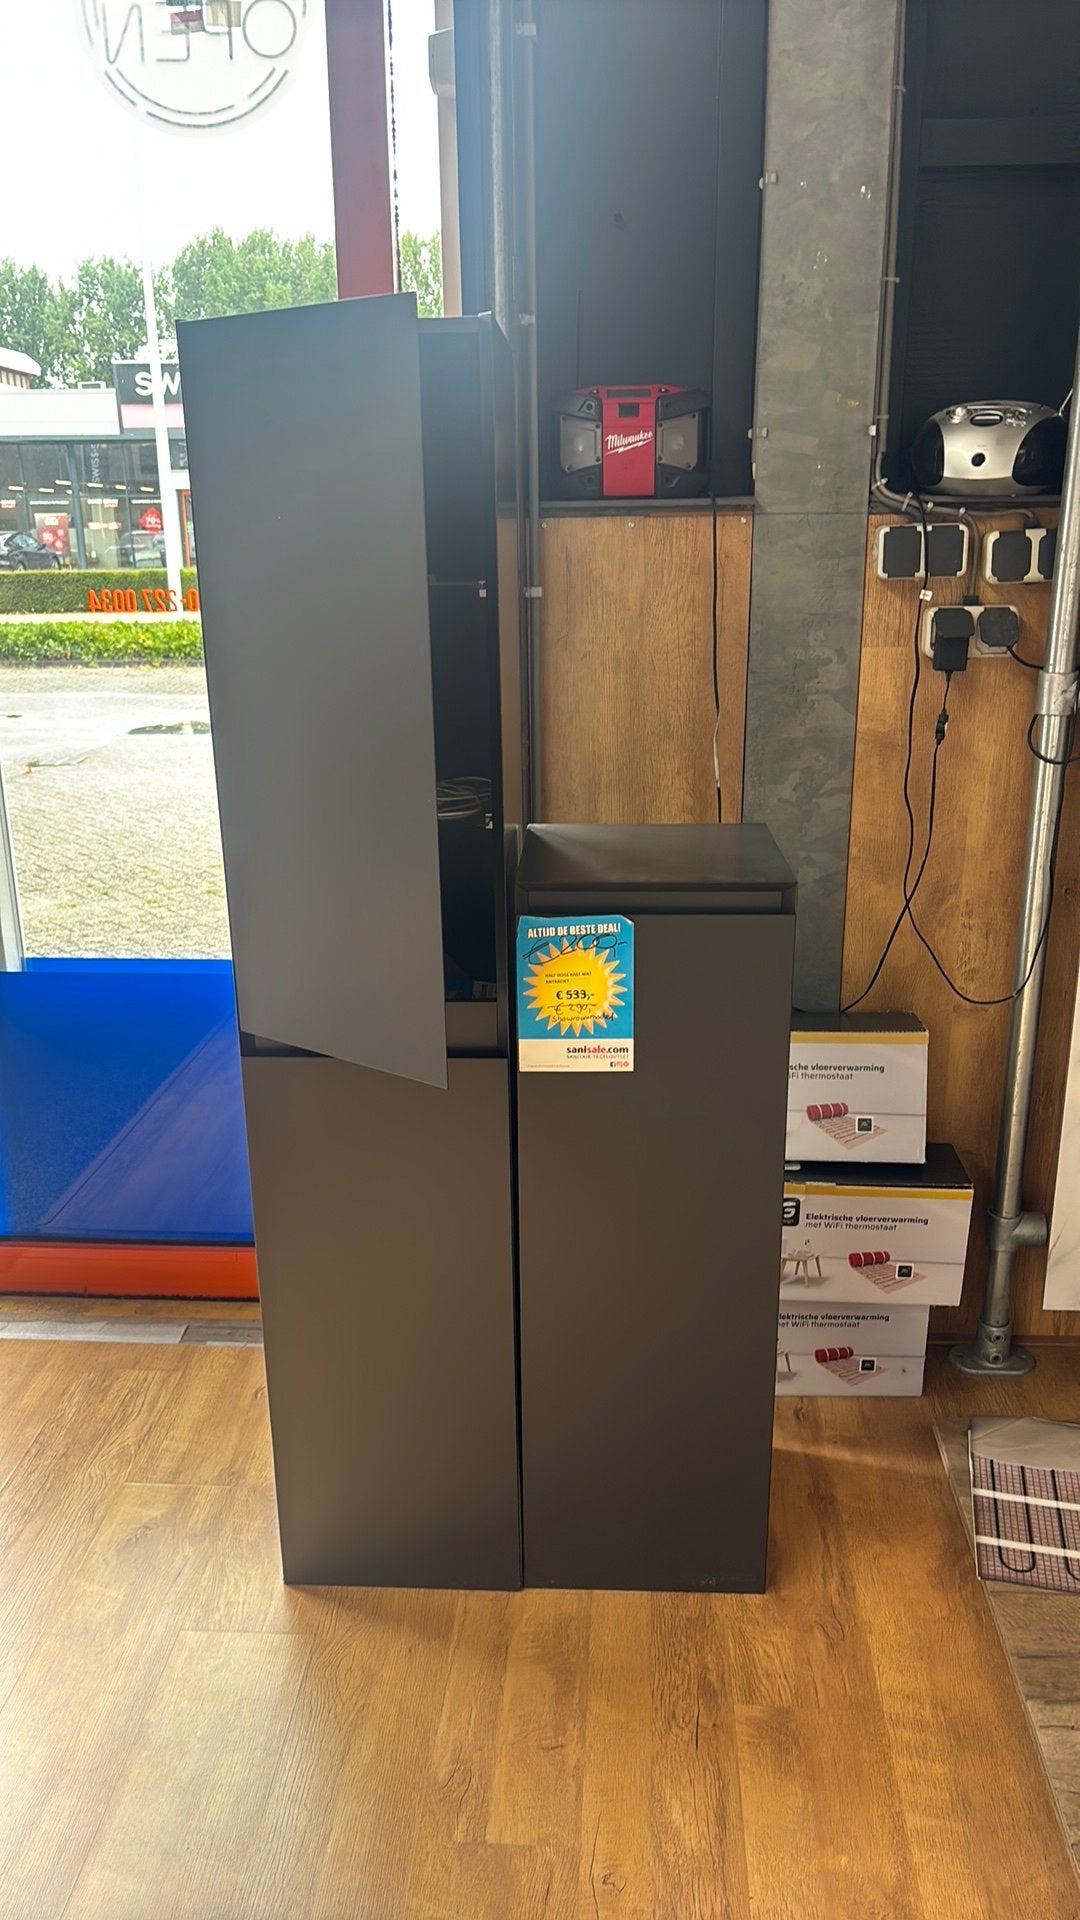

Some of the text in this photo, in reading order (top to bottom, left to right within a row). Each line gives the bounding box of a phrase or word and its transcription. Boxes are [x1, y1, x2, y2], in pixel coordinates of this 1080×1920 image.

[604, 430, 653, 450] Milwaukee
[527, 922, 621, 939] ALTIJD DE BESTE DEAL!
[556, 989, 596, 1001] € 533,-
[566, 1045, 629, 1054] sanisale.com
[811, 1063, 885, 1073] vloerverwarming
[801, 1072, 853, 1081] thermostaat
[806, 1213, 854, 1222] Elektrische
[855, 1214, 929, 1226] vloerverwarming
[805, 1221, 822, 1229] met
[824, 1222, 843, 1230] WiFi
[845, 1222, 897, 1232] thermostaat
[821, 1313, 890, 1322] vloerverwarming
